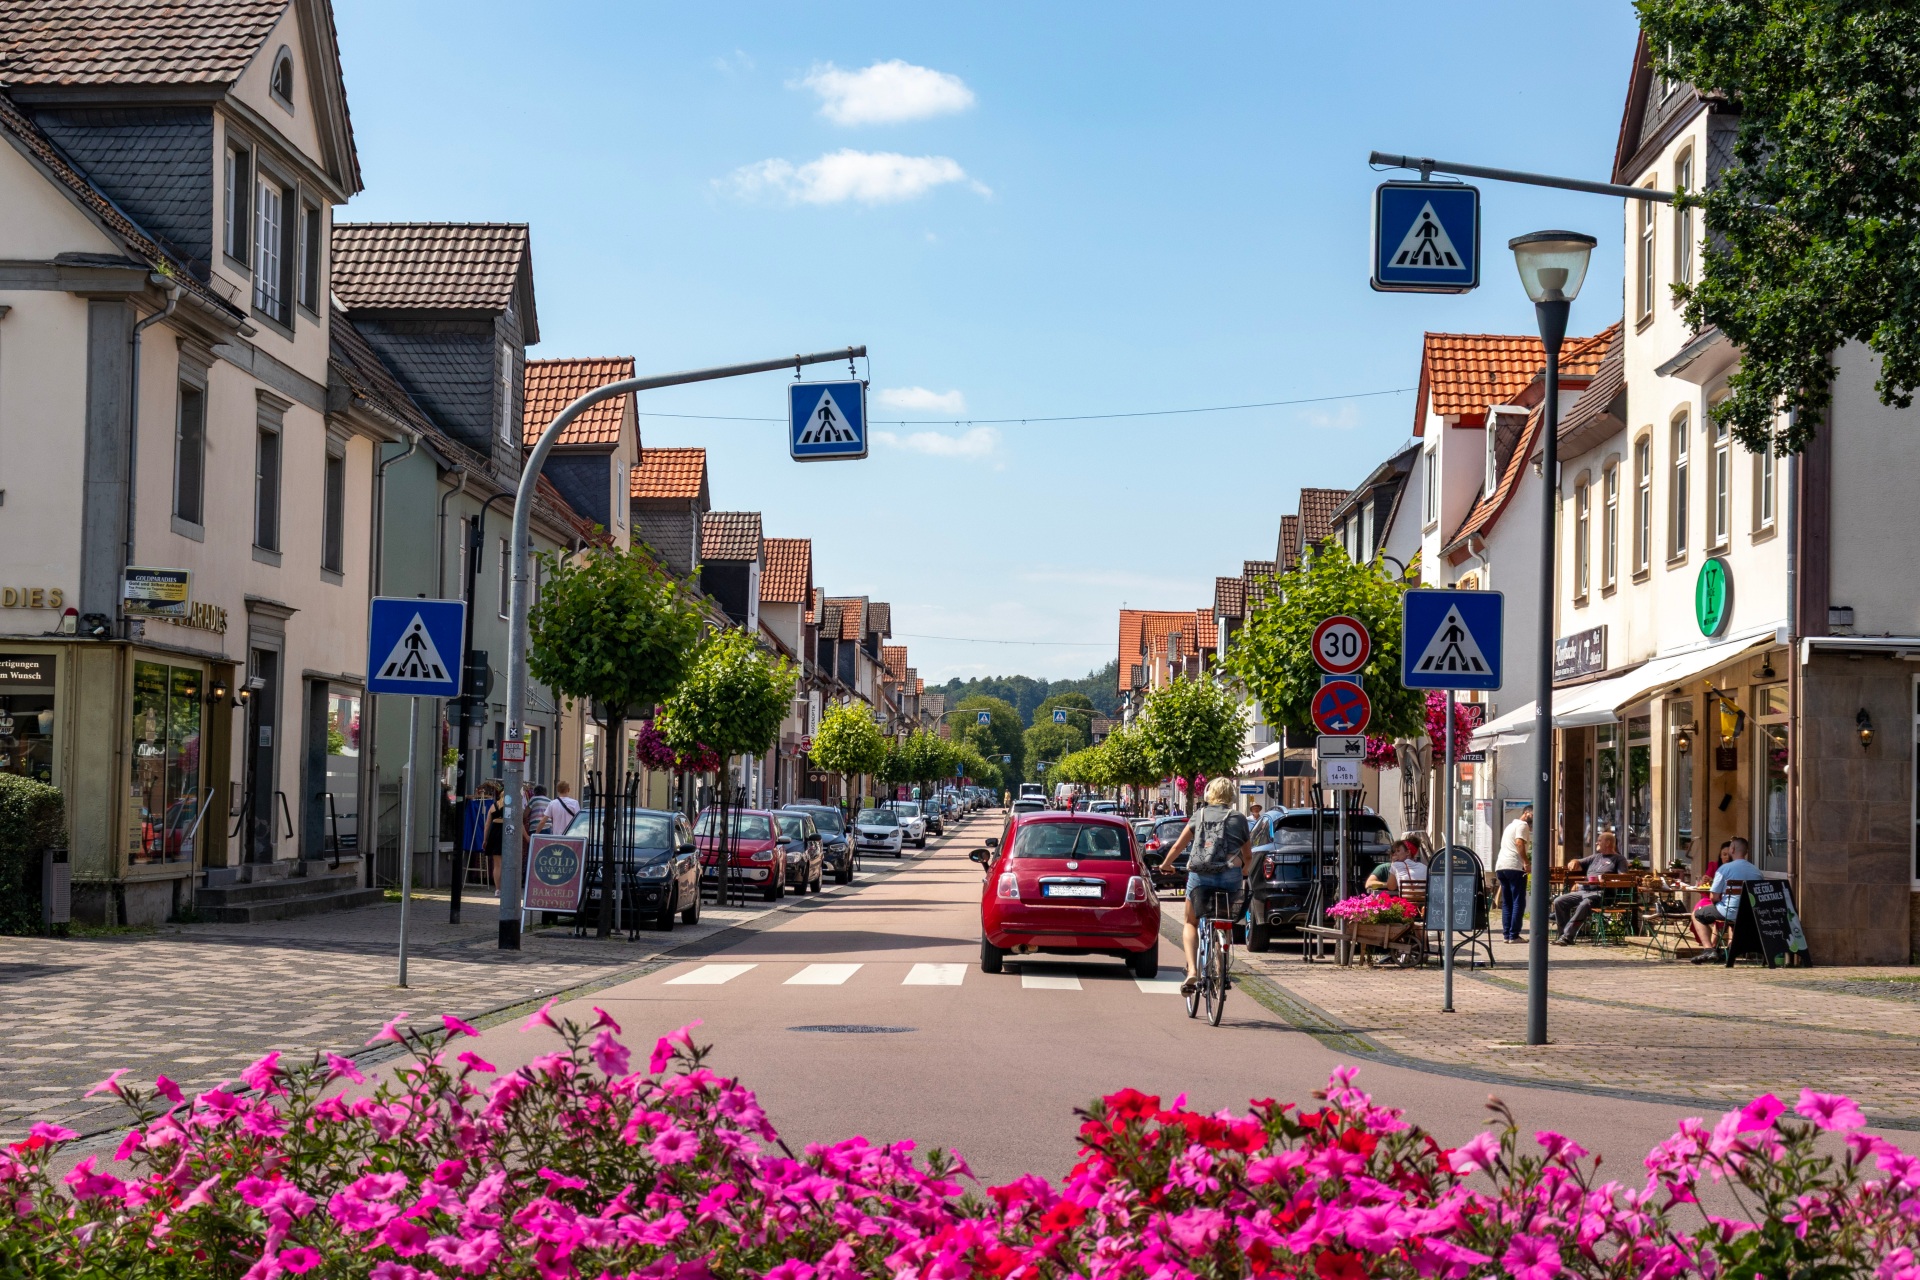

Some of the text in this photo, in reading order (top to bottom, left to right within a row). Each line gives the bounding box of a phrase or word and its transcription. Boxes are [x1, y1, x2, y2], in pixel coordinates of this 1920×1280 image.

[135, 575, 177, 583] GOLDPARADIES
[2, 587, 63, 608] DIES
[187, 600, 228, 634] ARADIES
[1324, 632, 1357, 658] 30
[10, 671, 42, 680] Wunsch
[538, 855, 575, 867] GOLD
[539, 866, 574, 874] ANKAUF
[532, 887, 574, 899] BARGELD
[1753, 886, 1762, 895] ICE
[1761, 884, 1775, 893] COLD
[1757, 891, 1784, 902] COCKTAILS
[530, 898, 573, 909] SOFORT
